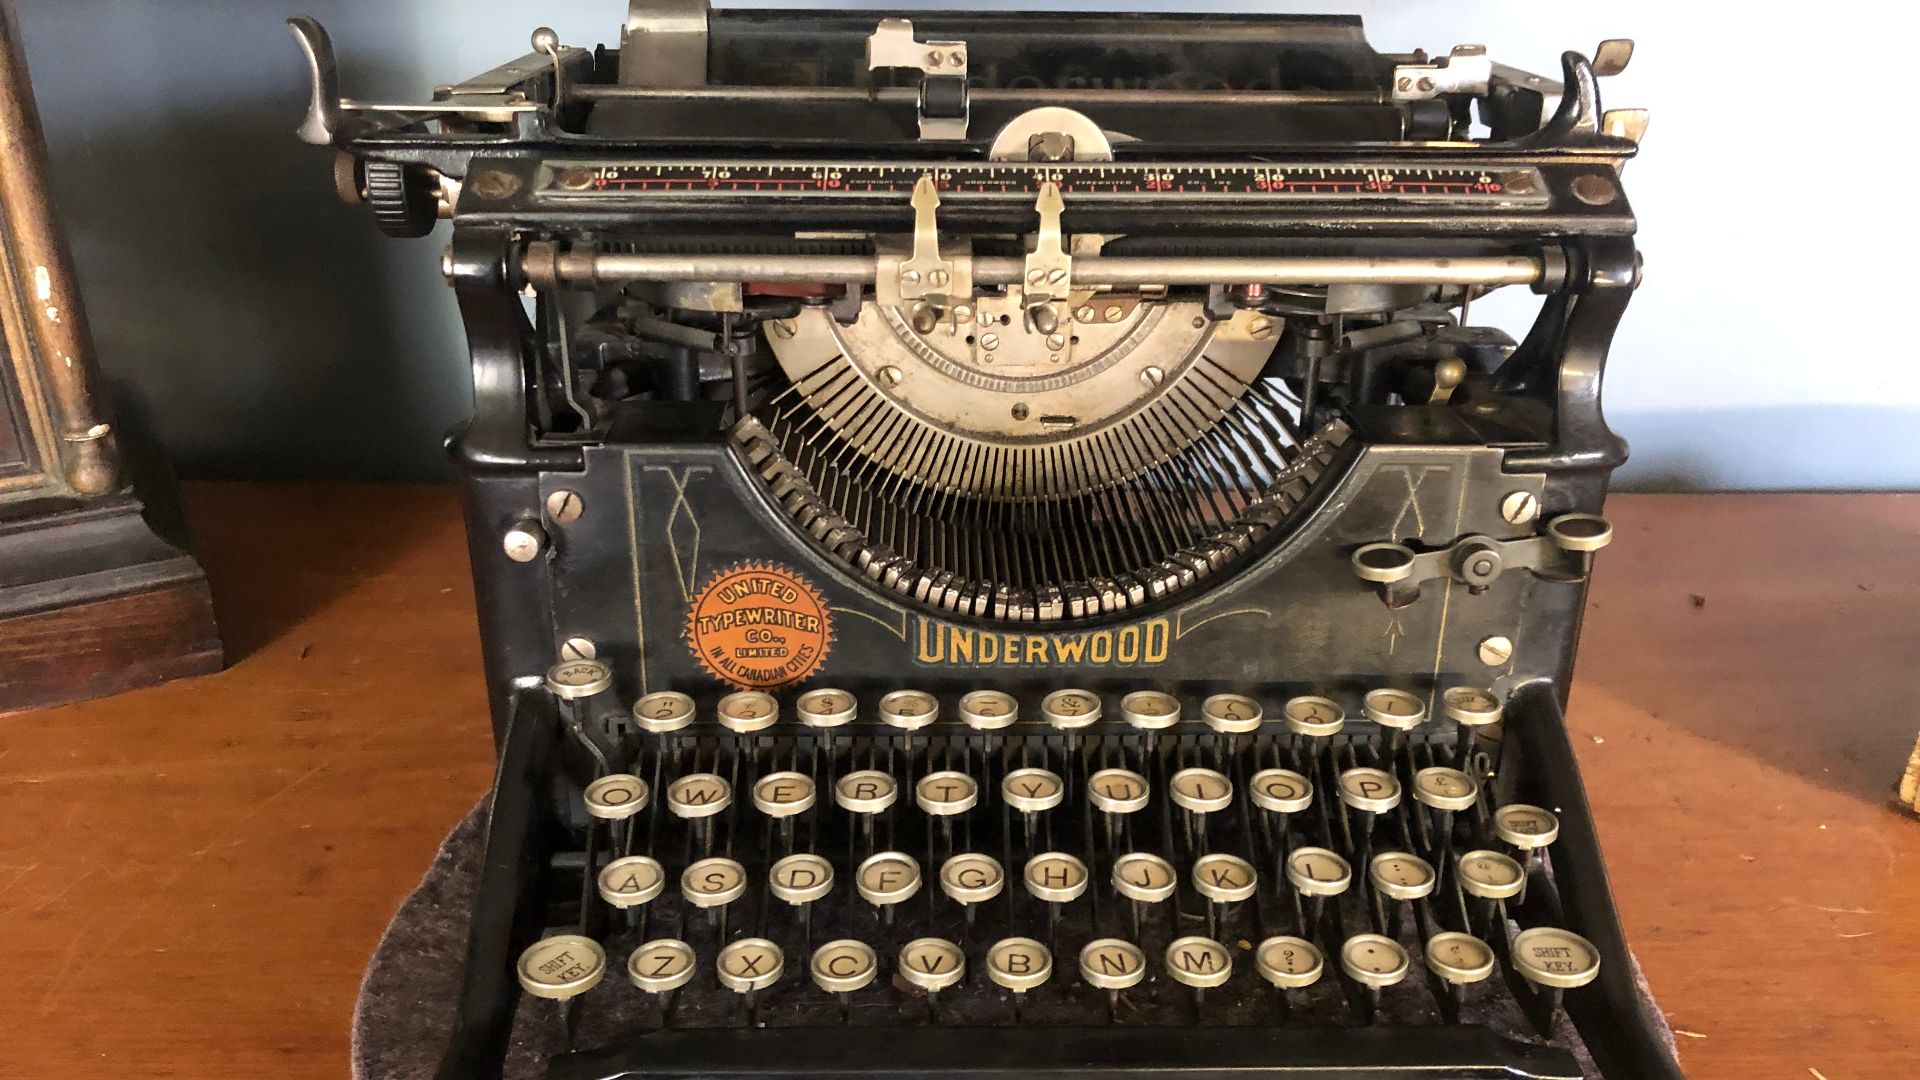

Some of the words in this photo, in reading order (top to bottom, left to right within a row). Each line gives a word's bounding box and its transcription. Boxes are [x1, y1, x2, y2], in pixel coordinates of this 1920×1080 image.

[717, 578, 799, 605] UNITED
[699, 607, 820, 635] TYPEWRITER
[915, 617, 1170, 665] UNDERWOOD
[710, 645, 725, 659] IN
[718, 656, 738, 675] ALL
[736, 664, 788, 681] CANADIAN
[786, 643, 814, 672] CITIES
[735, 646, 788, 659] LIMITED
[562, 667, 598, 678] BACK
[685, 788, 718, 806] W
[772, 785, 796, 803] E
[854, 783, 877, 801] R
[936, 785, 959, 802] T
[1022, 782, 1043, 798] Y
[1106, 784, 1131, 801] U
[1266, 783, 1296, 800] O
[1359, 781, 1382, 799] P
[788, 870, 815, 889] D
[879, 871, 902, 891] F
[957, 868, 987, 889] G
[1043, 867, 1068, 887] H
[1134, 869, 1150, 888] J
[1211, 868, 1239, 888] K
[1305, 863, 1333, 882] L
[618, 873, 641, 892] A
[701, 873, 726, 892] S
[538, 950, 575, 975] SHIFT
[1182, 951, 1214, 972] M
[1533, 947, 1571, 959] SHIFT
[651, 955, 676, 977] Z
[739, 954, 764, 976] X
[829, 955, 858, 976] C
[920, 954, 944, 975] V
[1008, 953, 1031, 974] B
[1099, 952, 1126, 975] N
